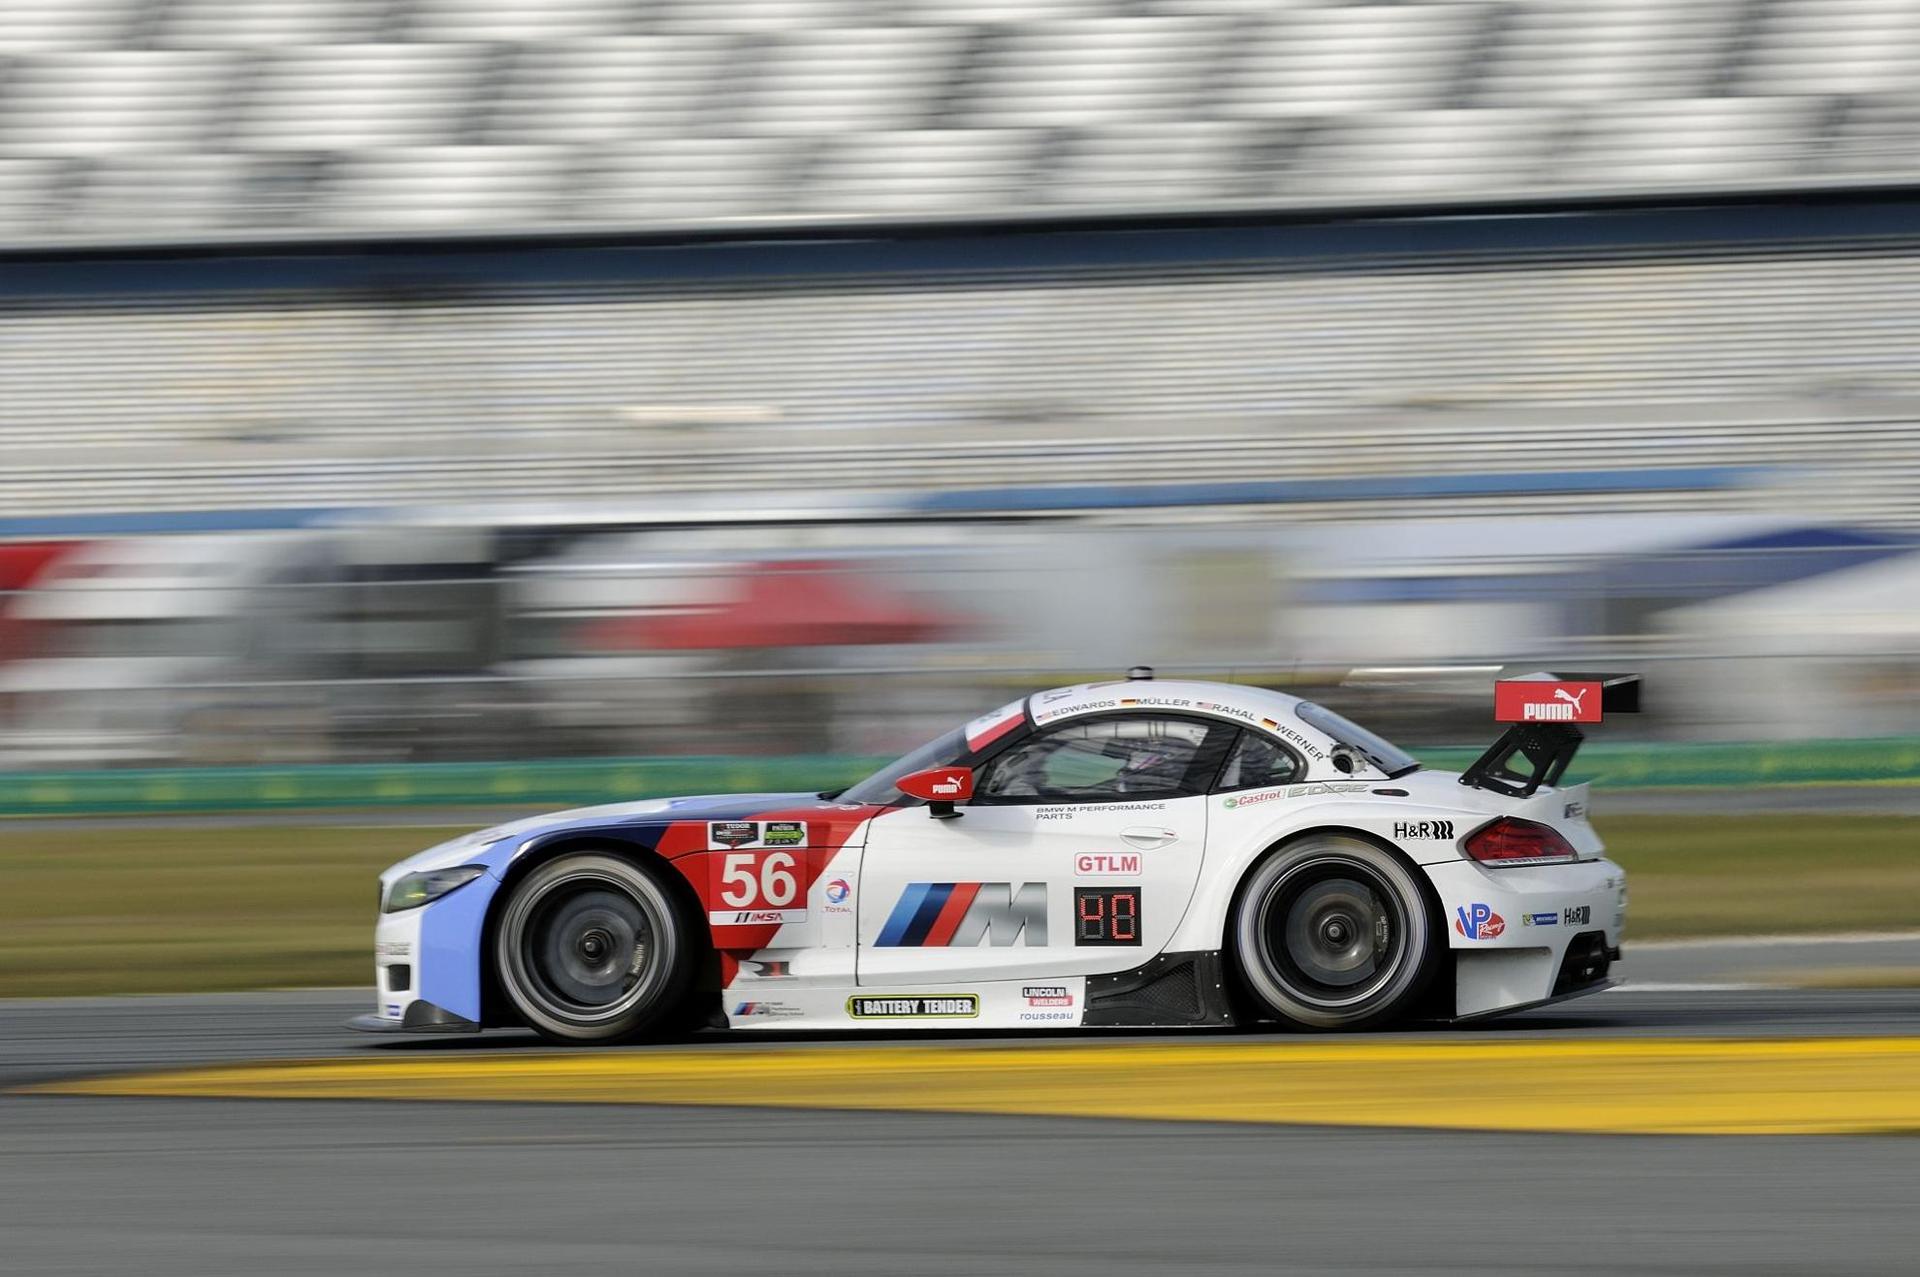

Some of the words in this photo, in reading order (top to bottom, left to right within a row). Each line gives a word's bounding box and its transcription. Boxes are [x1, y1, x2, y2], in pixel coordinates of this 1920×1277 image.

[1523, 703, 1574, 720] PUMA
[1051, 699, 1116, 717] EDWARDS
[1136, 697, 1191, 707] MÜLLER
[1211, 703, 1256, 721] RAHAL
[1276, 722, 1324, 762] WERNER
[932, 784, 958, 794] PUMA
[1238, 790, 1281, 806] Castrol
[1287, 783, 1369, 798] EDGE
[1079, 803, 1167, 812] PERFORMANCE
[1394, 822, 1430, 838] H&R
[1078, 856, 1138, 872] GTLM
[721, 852, 797, 908] 56
[750, 912, 784, 922] IMSA
[1079, 894, 1135, 939] 40
[1457, 903, 1491, 940] VP
[1564, 907, 1582, 926] H&R
[1024, 988, 1064, 997] LINCOLN
[863, 1000, 919, 1015] BATTERY
[922, 999, 973, 1013] TENDER
[1020, 1012, 1073, 1020] rousseau
